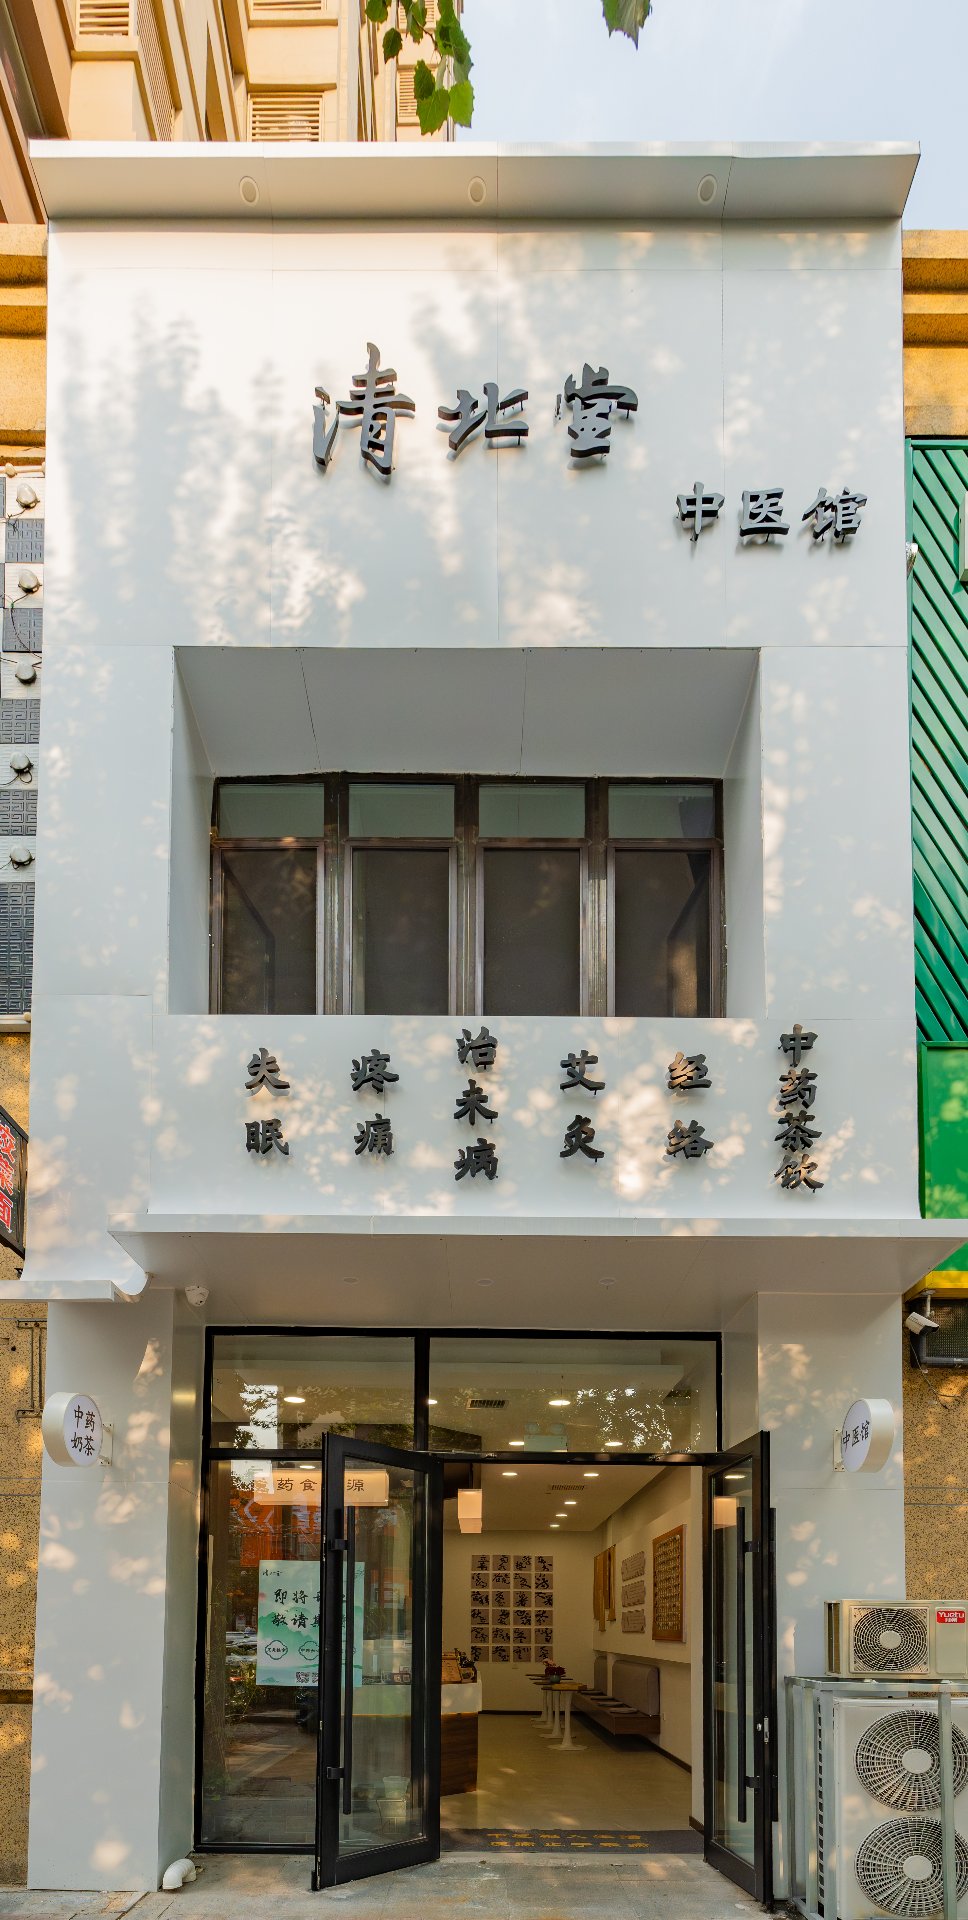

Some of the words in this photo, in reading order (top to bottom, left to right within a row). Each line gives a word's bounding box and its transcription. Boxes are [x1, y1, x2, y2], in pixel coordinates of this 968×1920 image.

[312, 342, 639, 475] 清北堂
[676, 482, 867, 542] 中医馆
[244, 1047, 290, 1156] 失眠
[351, 1049, 399, 1157] 疼痛
[455, 1026, 499, 1182] 治未病
[559, 1050, 606, 1161] 艾灸
[666, 1051, 714, 1159] 经络
[774, 1023, 824, 1193] 中药茶饮
[71, 1432, 95, 1456] 奶茶
[73, 1404, 95, 1432] 中药
[842, 1420, 870, 1452] 中医馆
[276, 1478, 365, 1492] 药食源
